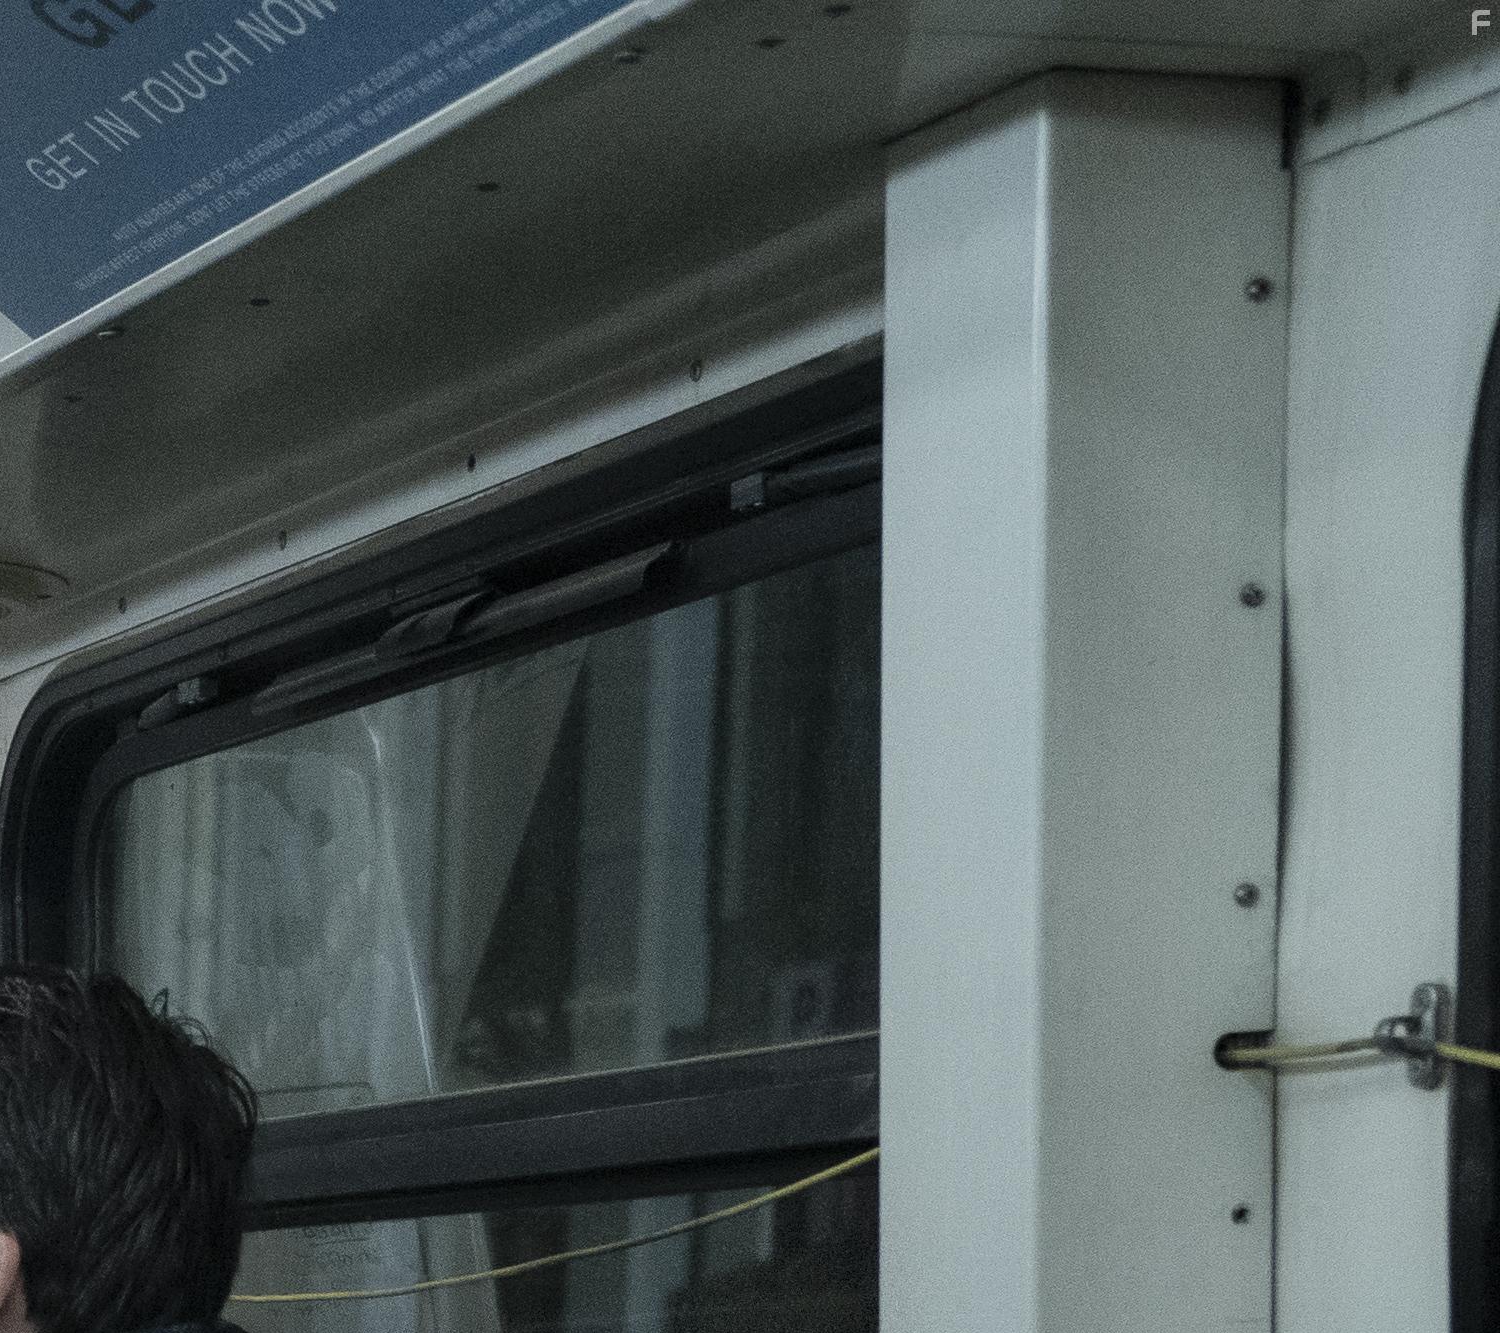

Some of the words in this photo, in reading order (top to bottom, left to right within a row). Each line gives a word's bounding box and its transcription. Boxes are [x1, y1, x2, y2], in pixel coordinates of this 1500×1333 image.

[26, 132, 100, 190] GET
[84, 111, 142, 153] IN
[119, 32, 255, 126] TOUCH
